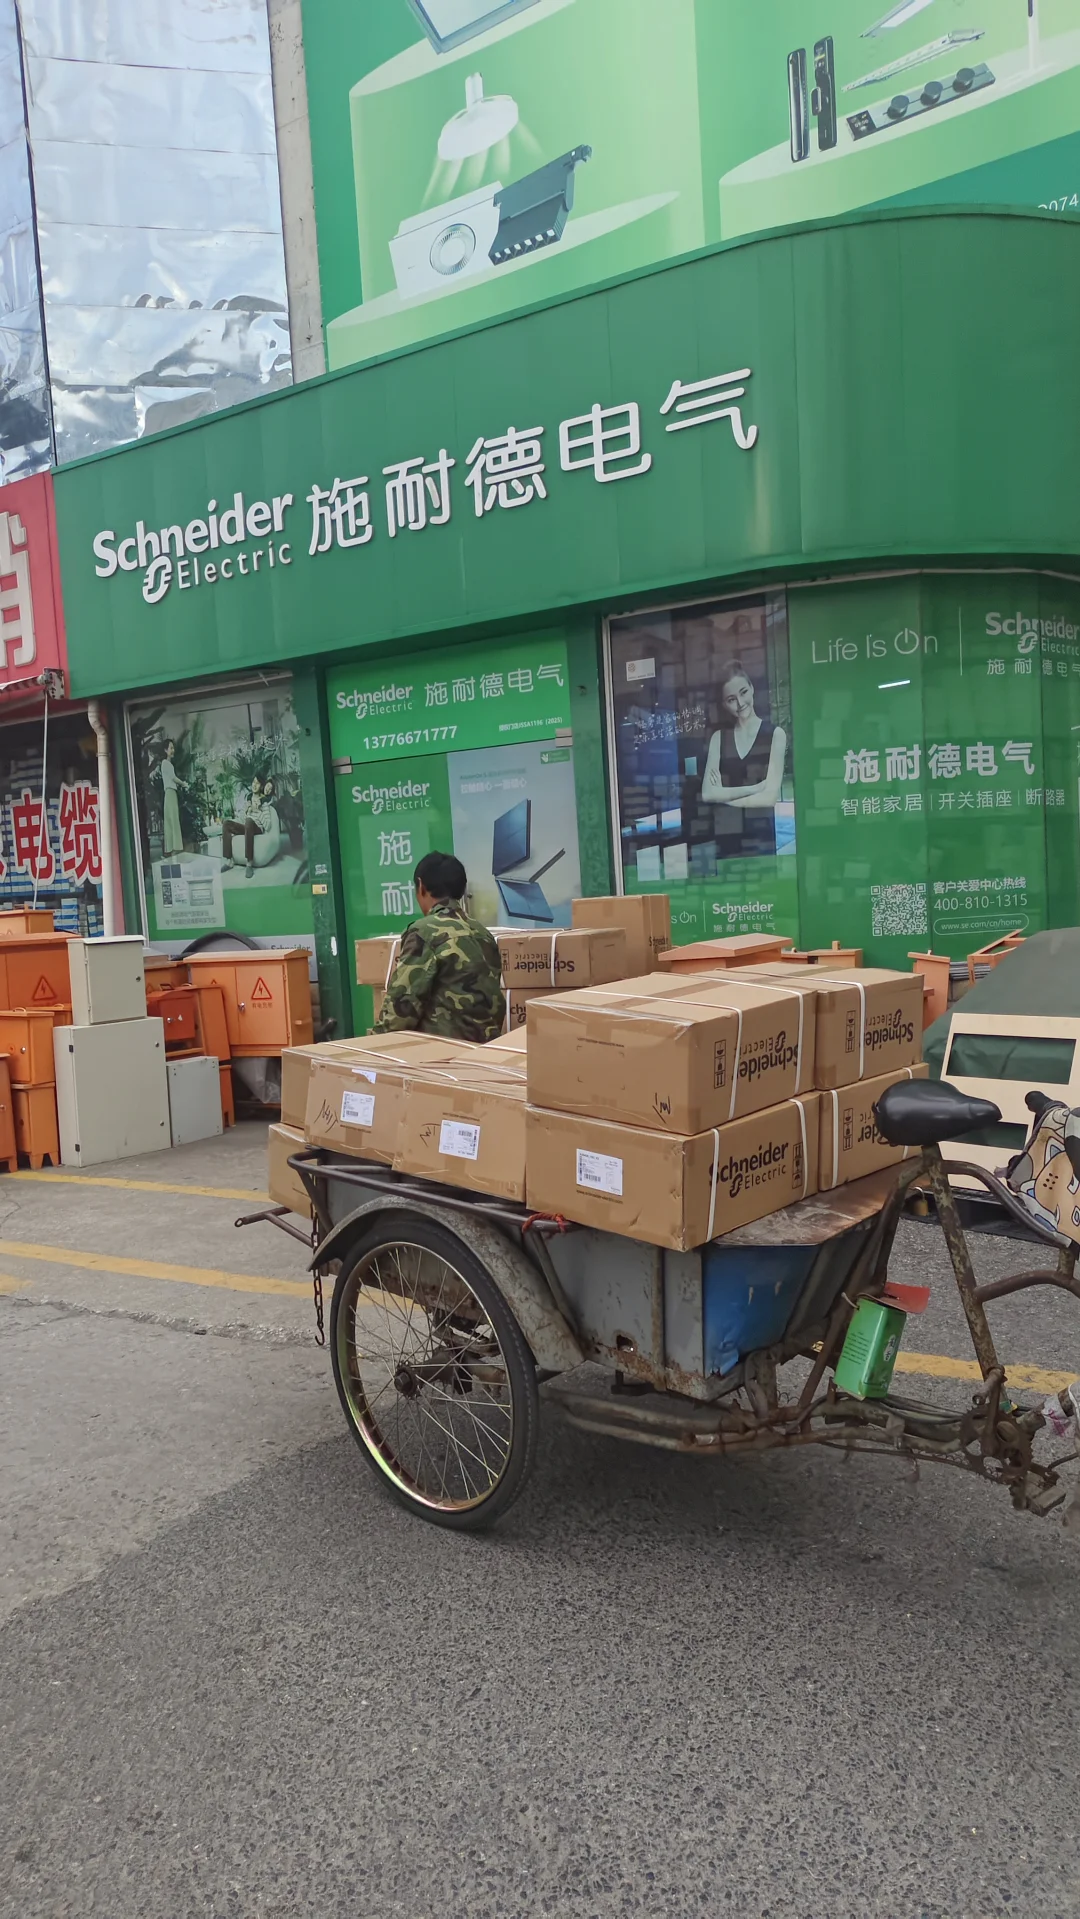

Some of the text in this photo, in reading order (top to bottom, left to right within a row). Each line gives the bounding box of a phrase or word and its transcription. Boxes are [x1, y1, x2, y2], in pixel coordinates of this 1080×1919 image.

[306, 368, 758, 556] 施耐德电气
[92, 491, 294, 578] Schneider
[177, 540, 292, 589] Electric
[985, 611, 1080, 640] Schneider
[811, 637, 858, 664] Life
[866, 634, 887, 659] Is
[1040, 637, 1080, 657] Electric
[336, 683, 414, 710] Schneider
[423, 663, 565, 708] 施耐德电气
[369, 700, 413, 716] Electric
[363, 725, 458, 750] 13776671777
[843, 740, 1036, 785] 施耐德电气
[352, 779, 430, 804] Schneider
[840, 788, 1065, 817] 智能家居 开关插座 断路器
[385, 797, 430, 812] Electric
[933, 877, 1027, 895] 客户关爱中心热线
[712, 900, 774, 915] Schneider
[933, 893, 1028, 911] 400-810-1315
[713, 923, 776, 933] 施耐德电气
[738, 913, 774, 921] Electric
[941, 919, 1022, 930] www.se.com/cn/home
[515, 950, 548, 961] Electric
[865, 1012, 893, 1027] Electri
[859, 1022, 914, 1051] Schneide
[744, 1163, 787, 1189] Electric
